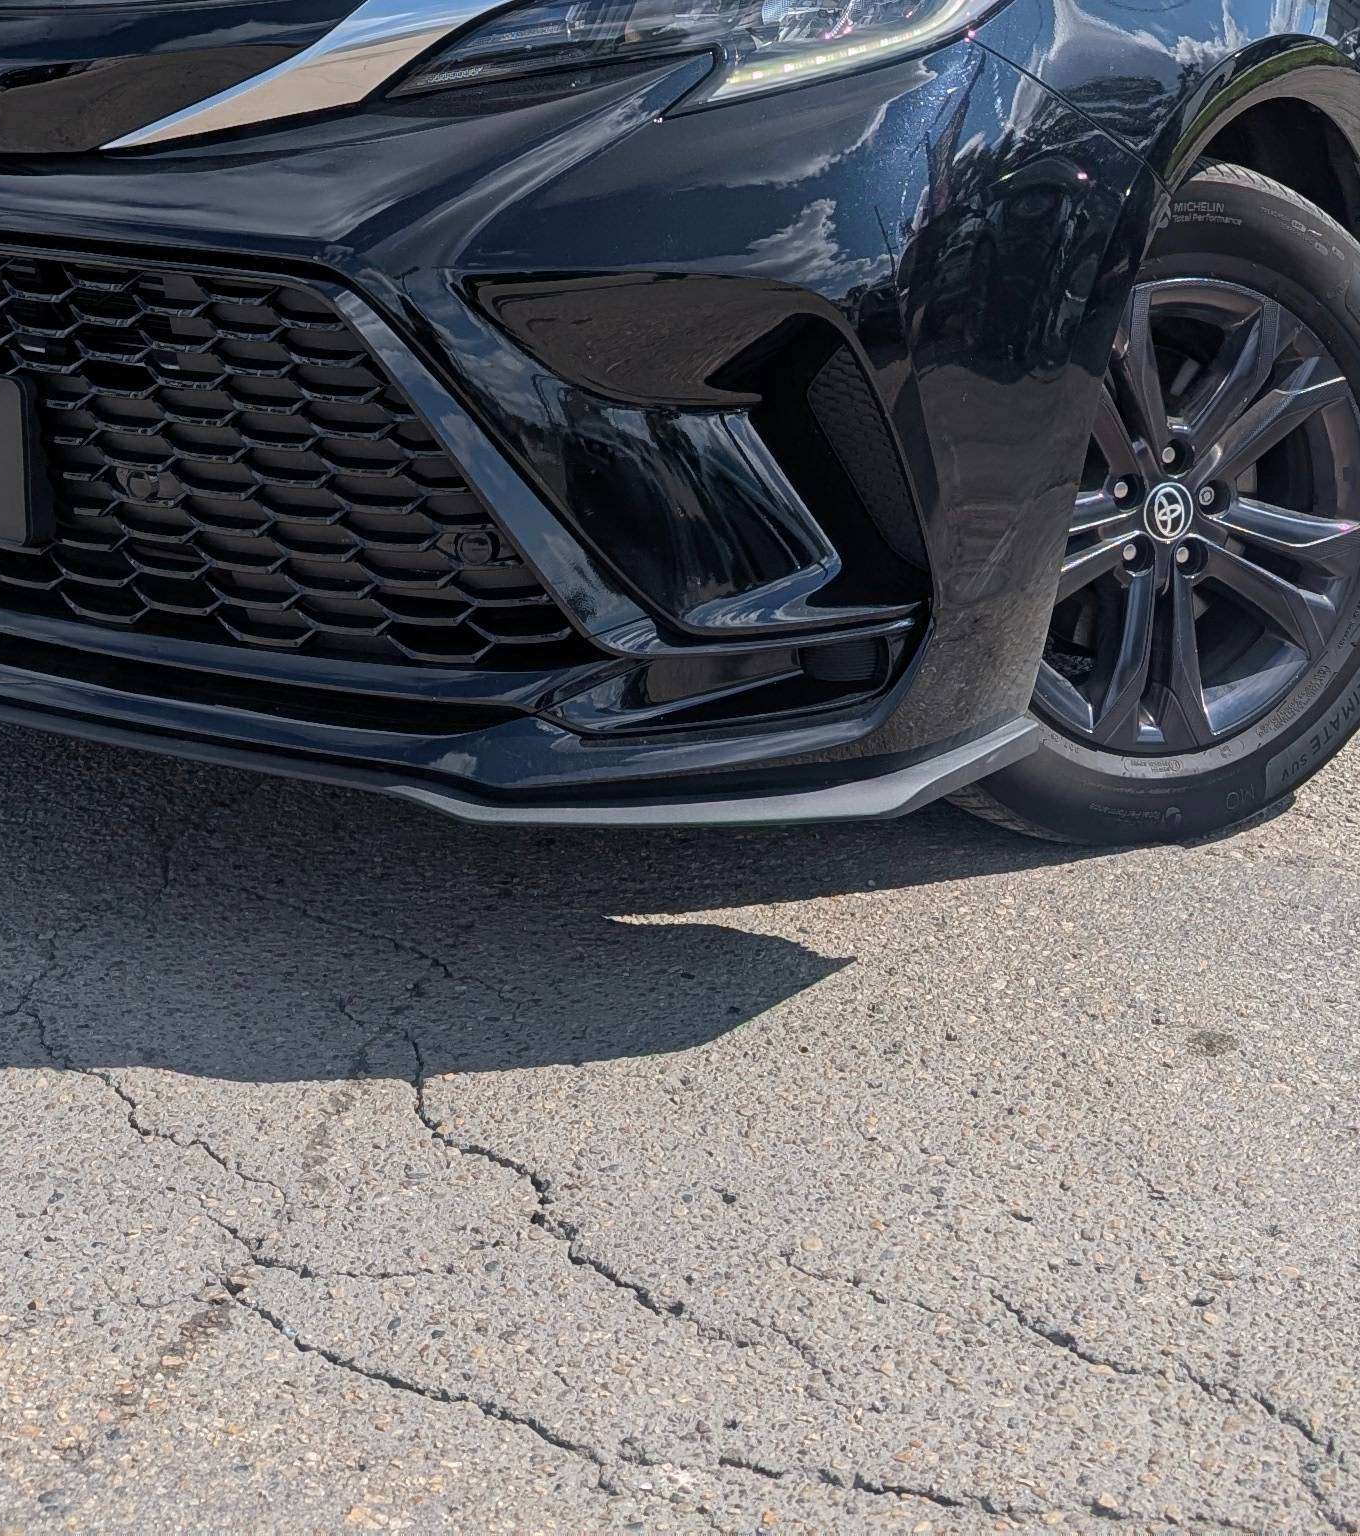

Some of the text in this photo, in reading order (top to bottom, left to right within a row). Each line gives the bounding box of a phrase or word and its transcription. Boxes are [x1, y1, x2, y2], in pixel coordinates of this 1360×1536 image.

[1173, 201, 1225, 214] MICHELIN
[1192, 214, 1242, 226] Performance
[1281, 753, 1308, 782] SUV
